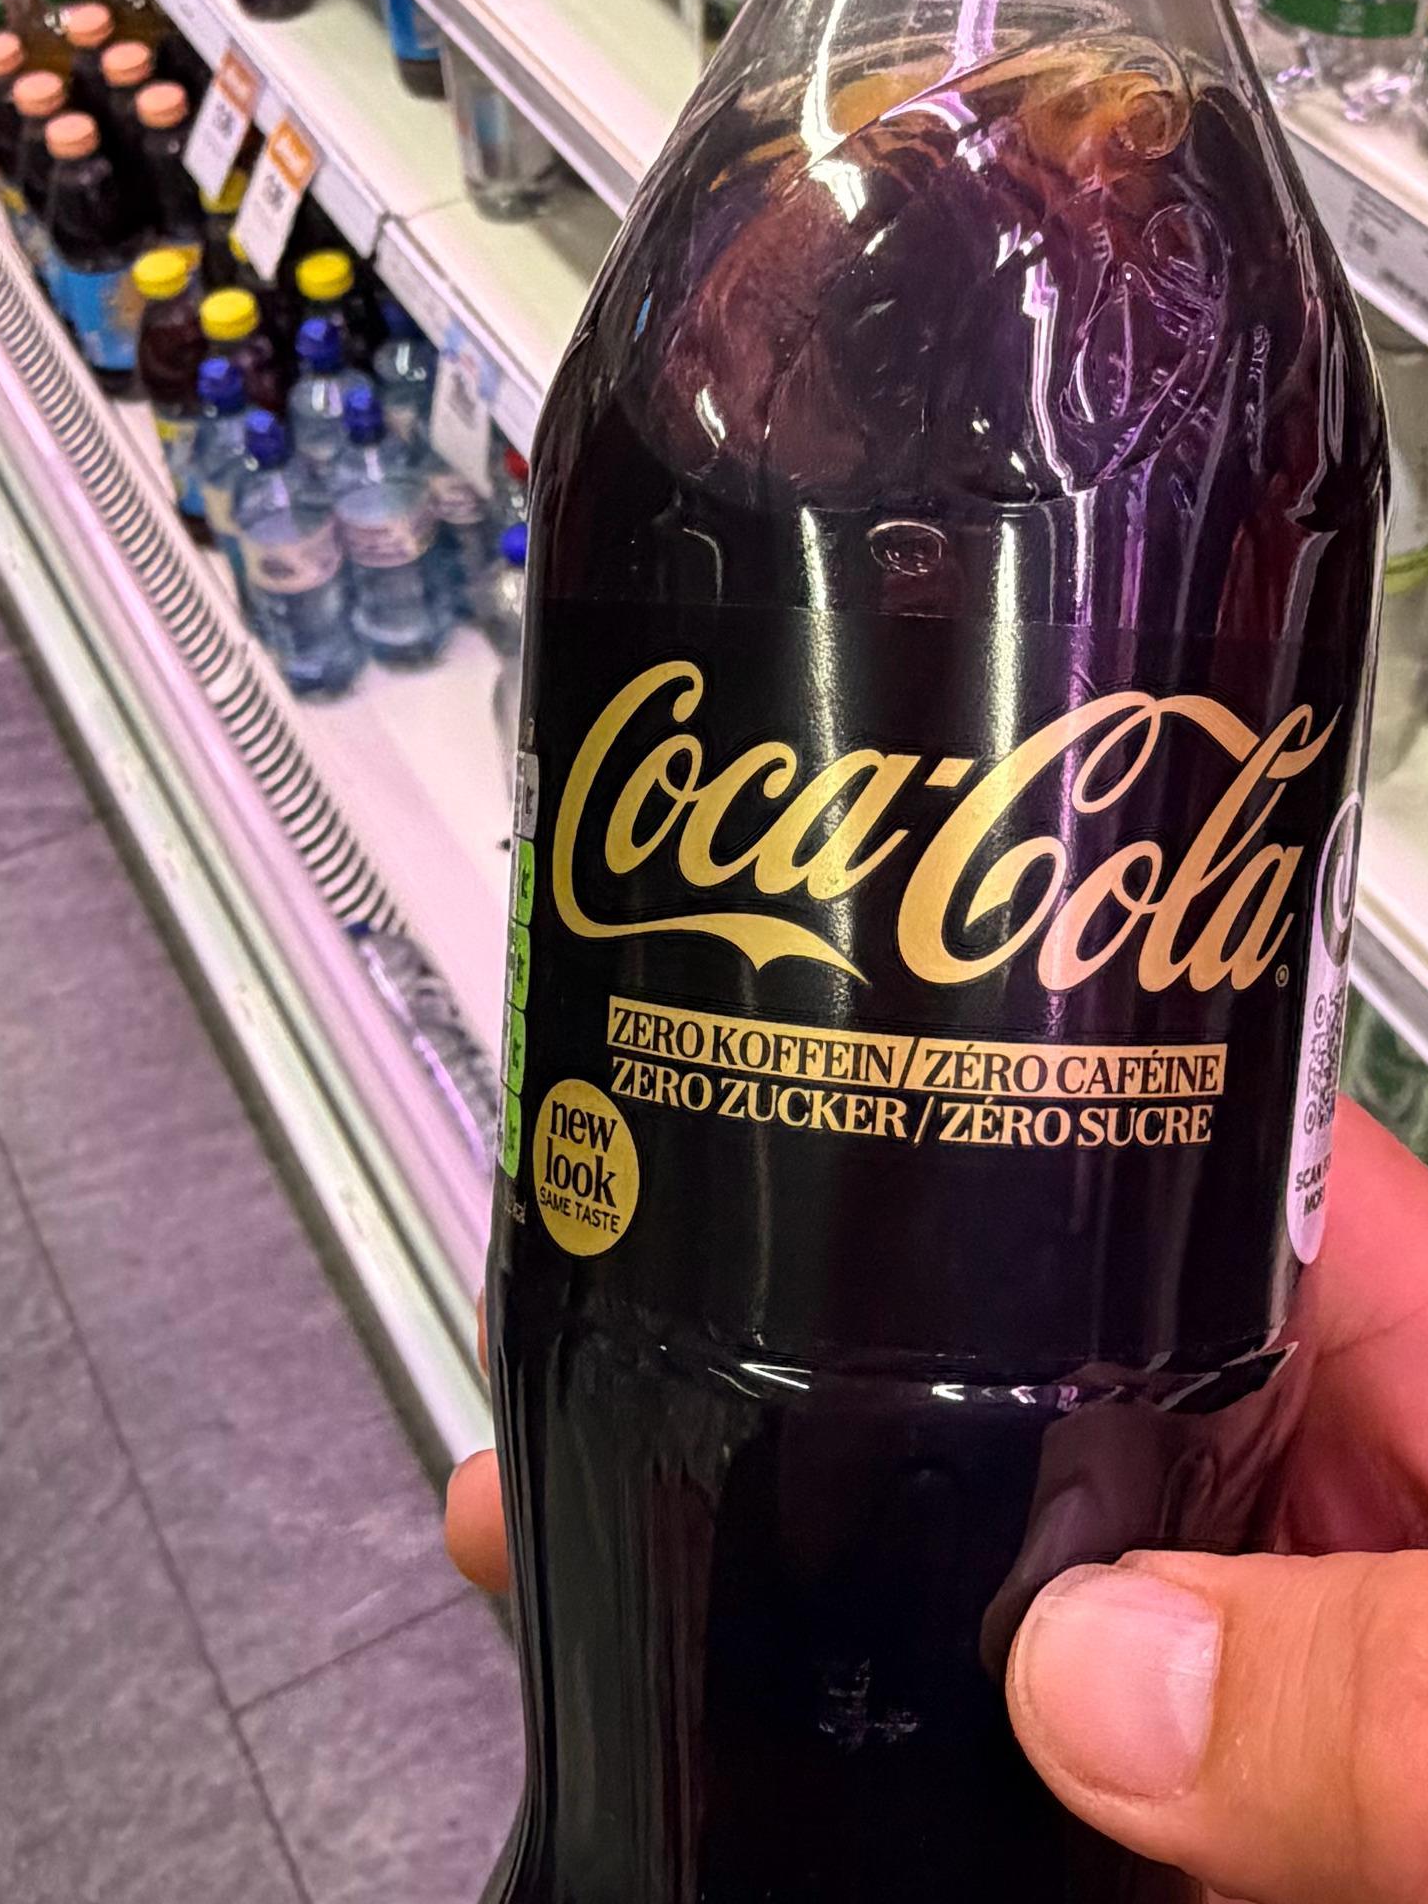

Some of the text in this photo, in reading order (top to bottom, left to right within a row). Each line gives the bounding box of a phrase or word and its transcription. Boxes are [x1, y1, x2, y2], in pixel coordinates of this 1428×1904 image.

[552, 659, 1343, 994] Coca-Cola
[612, 1007, 705, 1059] ZERO
[710, 1024, 897, 1085] KOFFEIN
[922, 1043, 1048, 1093] ZÉRO
[1056, 1049, 1221, 1095] CAFÉINE
[550, 1099, 618, 1153] new
[611, 1056, 713, 1112] ZERO
[717, 1078, 915, 1138] ZUCKER
[938, 1096, 1071, 1147] ZÉRO
[1077, 1104, 1214, 1147] SUCRE
[538, 1185, 621, 1235] SAME TASTE
[544, 1136, 617, 1208] look
